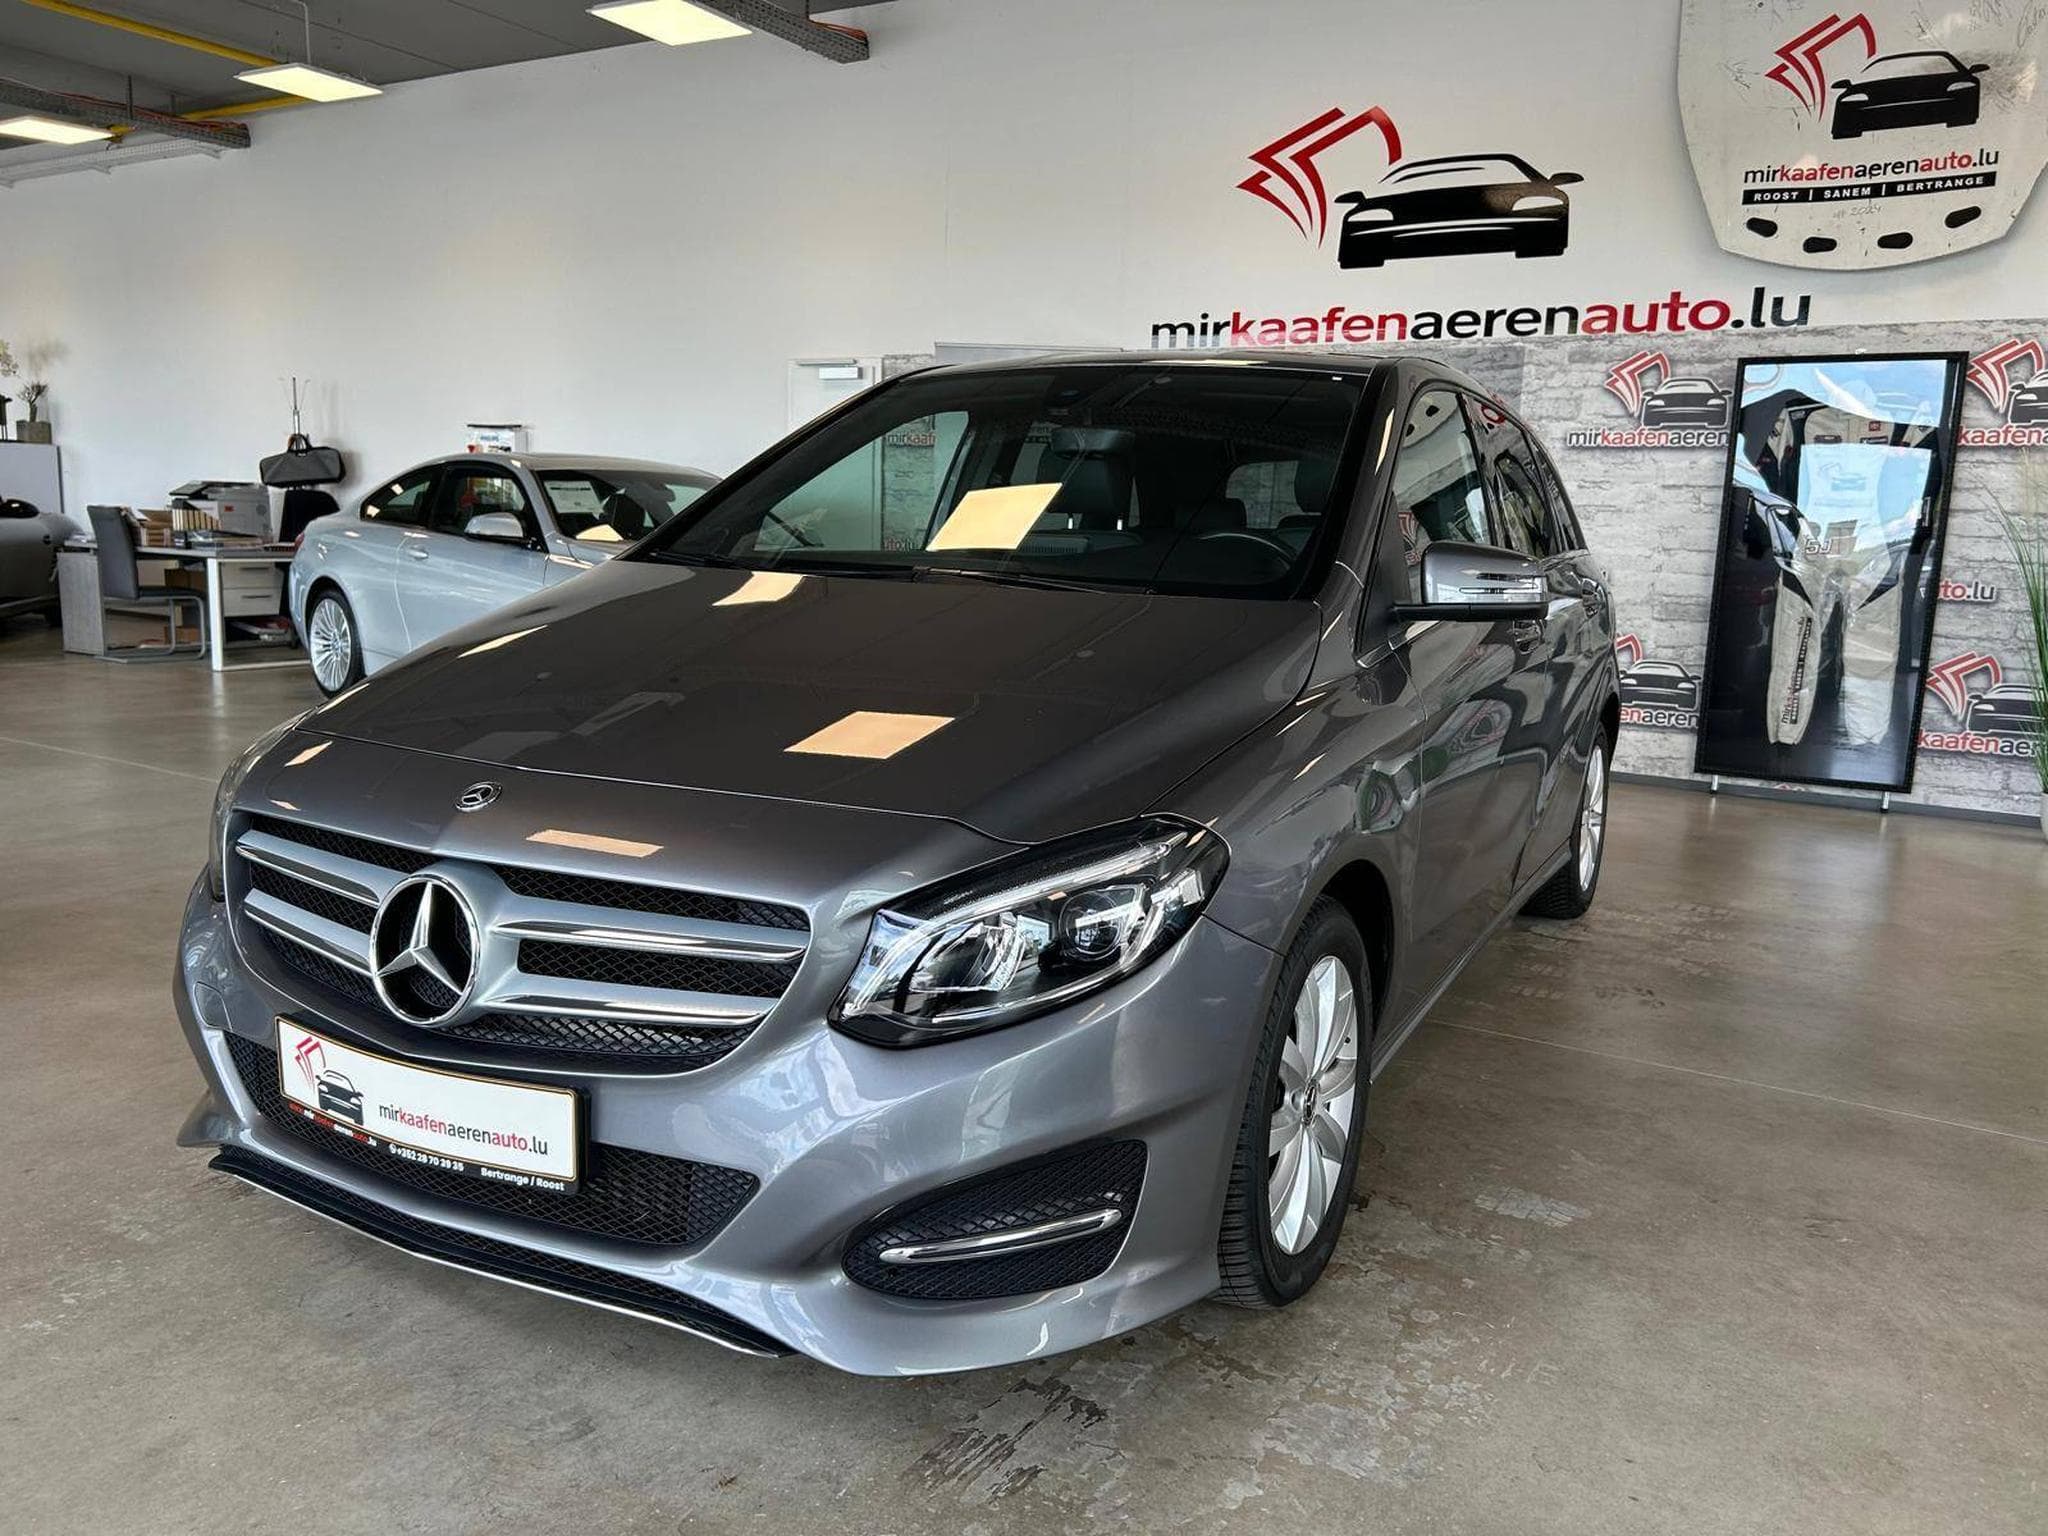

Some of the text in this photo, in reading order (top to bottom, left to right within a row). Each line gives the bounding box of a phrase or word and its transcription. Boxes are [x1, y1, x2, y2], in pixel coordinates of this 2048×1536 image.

[1744, 148, 1999, 184] mirkaafenaerenauto.lu
[1753, 190, 1798, 202] ROOST
[1823, 186, 1872, 200] SANEM
[1896, 175, 1985, 194] BERTRANGE
[1151, 286, 1812, 348] mirkaafenaerenauto.lu
[379, 1103, 549, 1156] mirkaafenaerenauto.lu
[428, 1156, 440, 1166] 70
[480, 1167, 530, 1186] Bertrange
[536, 1177, 565, 1191] Roost
